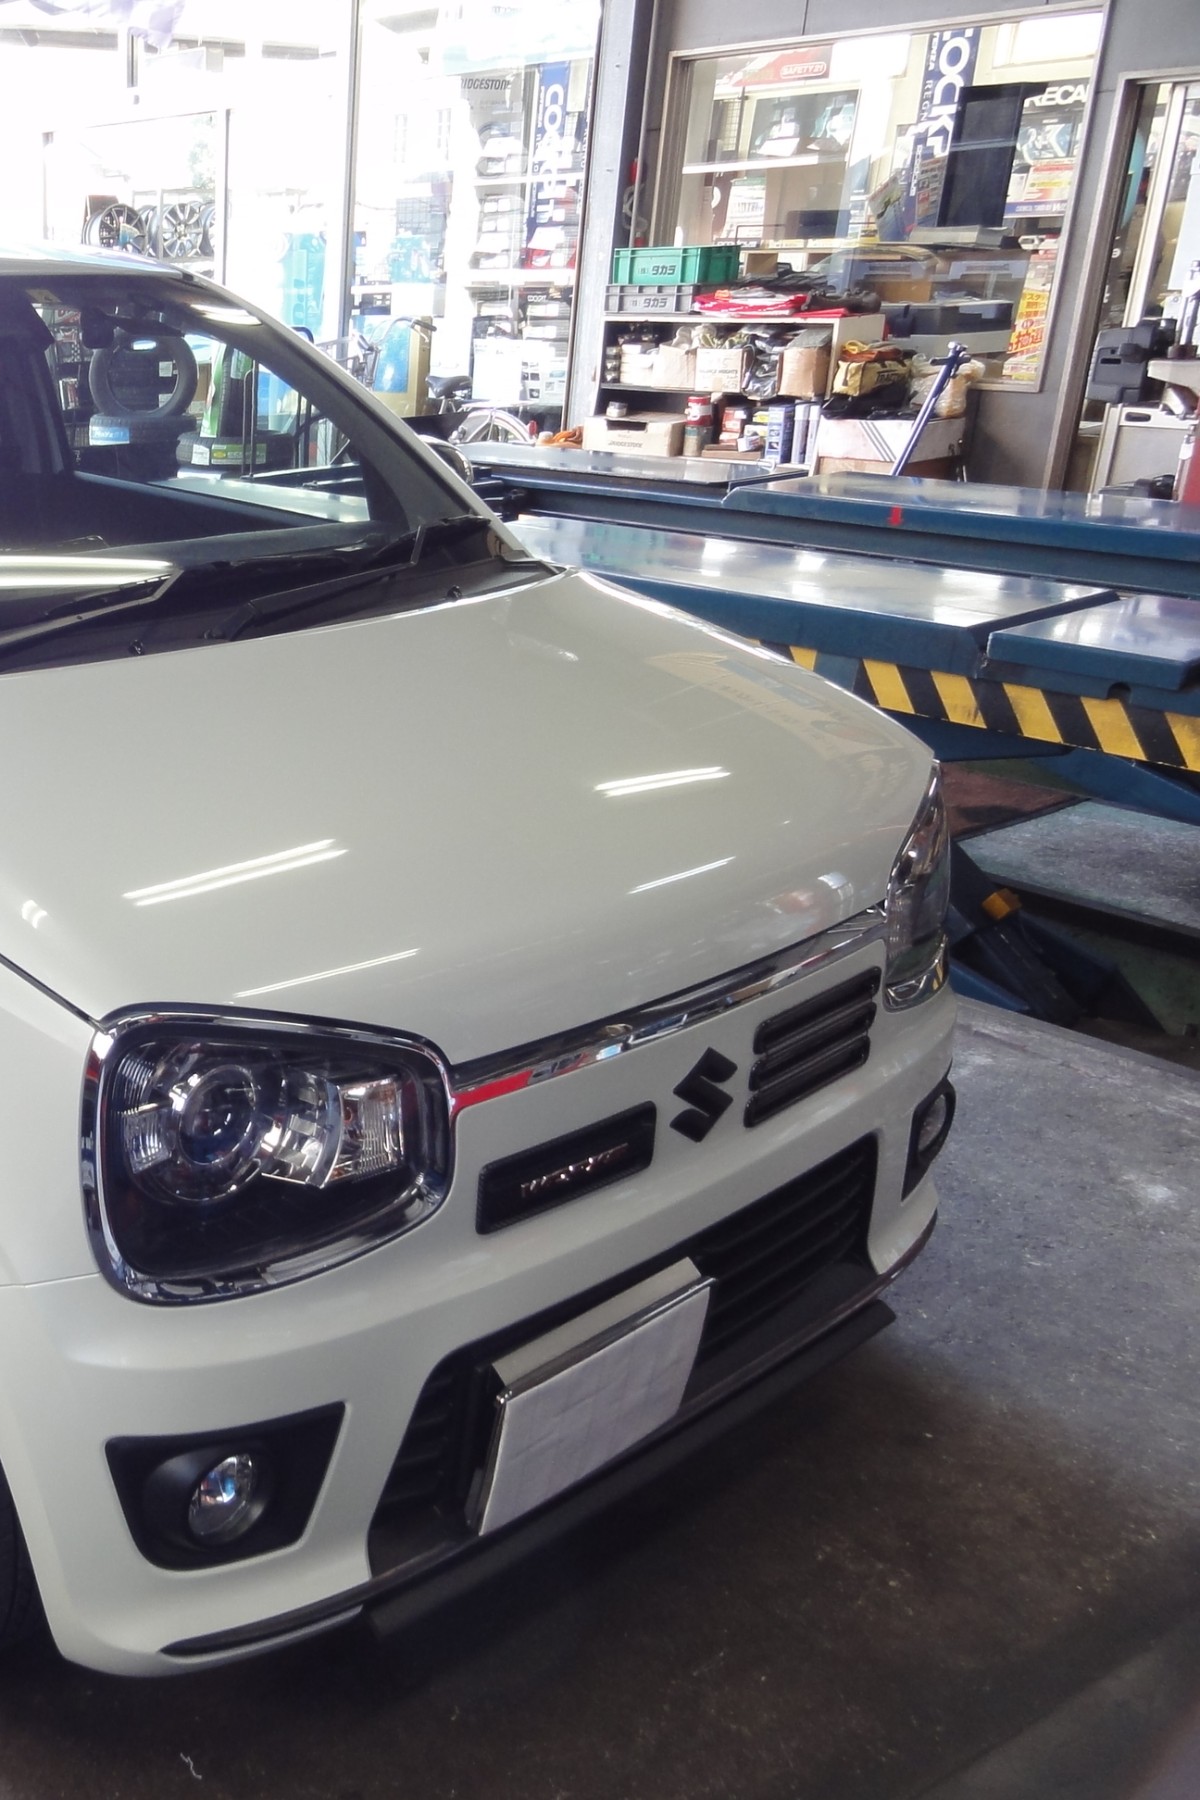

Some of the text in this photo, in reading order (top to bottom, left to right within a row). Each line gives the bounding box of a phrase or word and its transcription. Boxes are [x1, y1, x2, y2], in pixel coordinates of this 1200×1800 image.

[1023, 84, 1090, 108] RECA
[652, 264, 677, 275] タカラ
[643, 297, 668, 309] タカラ
